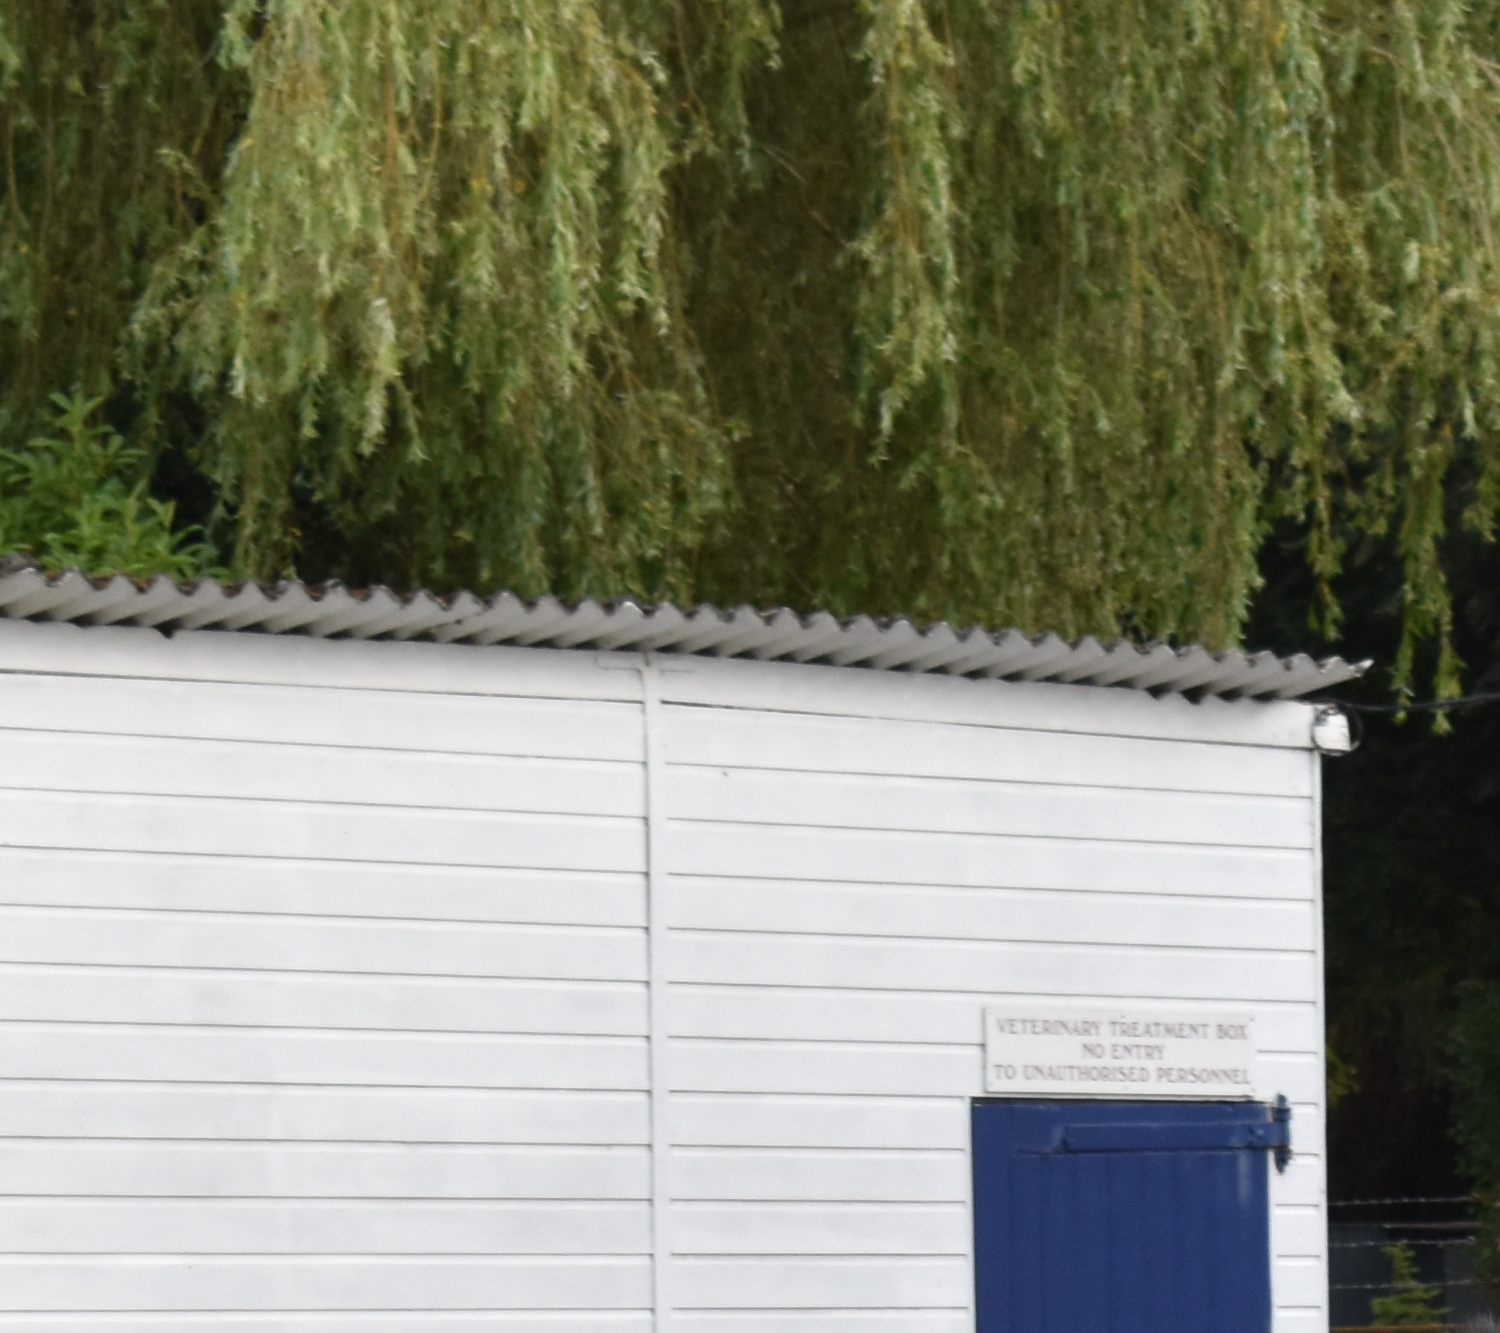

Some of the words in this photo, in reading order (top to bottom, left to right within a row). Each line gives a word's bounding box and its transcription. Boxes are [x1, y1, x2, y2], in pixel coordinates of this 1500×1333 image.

[997, 1018, 1101, 1036] VETERINARY
[1109, 1021, 1209, 1039] TREATMENT
[1216, 1024, 1249, 1039] BOX
[1082, 1043, 1105, 1059] NO
[1111, 1044, 1165, 1060] ENTRY
[994, 1064, 1017, 1080] TO
[1023, 1065, 1150, 1082] UNAUTHORISED
[1156, 1067, 1251, 1085] PERSONNEL
